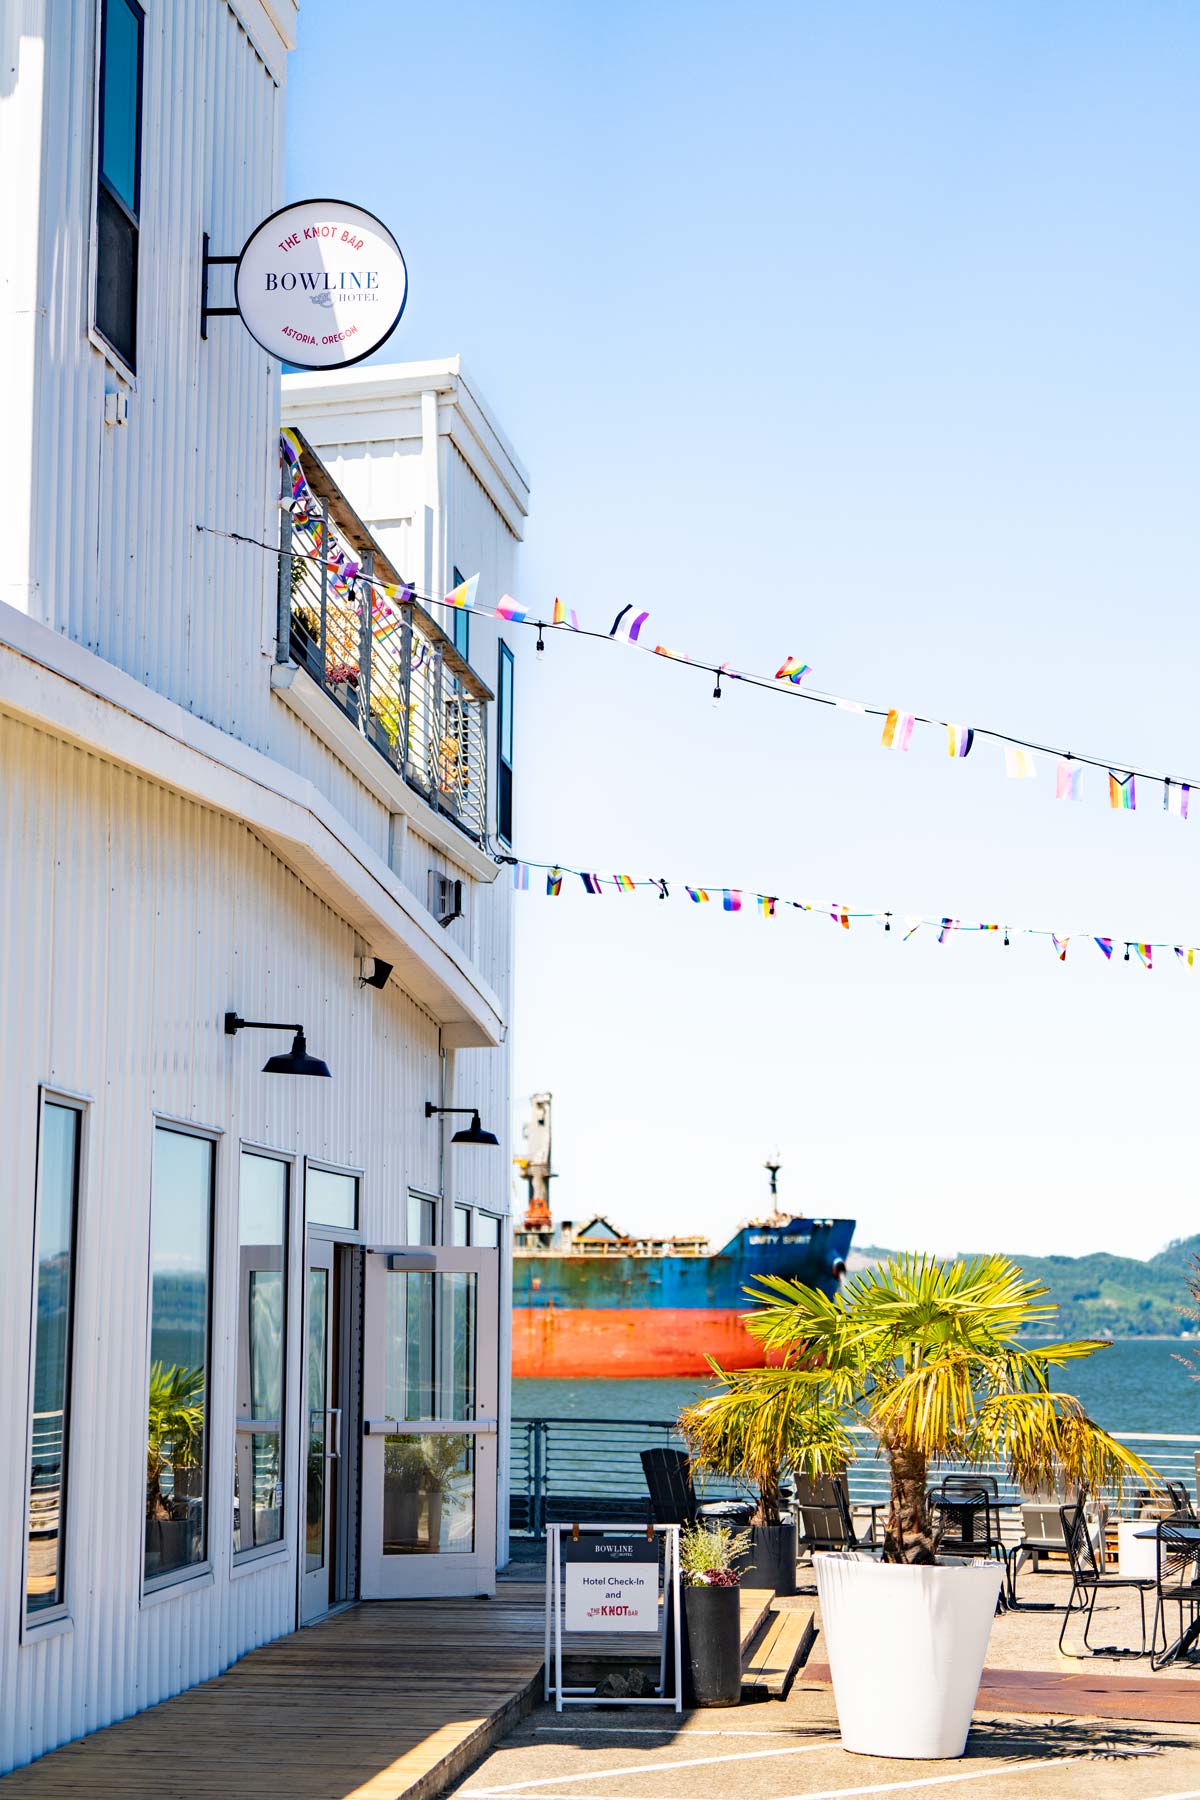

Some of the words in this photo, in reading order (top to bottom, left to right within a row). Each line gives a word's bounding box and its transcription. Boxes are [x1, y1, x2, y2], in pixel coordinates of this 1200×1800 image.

[278, 233, 301, 252] THE
[303, 226, 338, 240] KNOT
[341, 230, 365, 251] BAR
[264, 271, 379, 290] BOWLINE
[339, 293, 379, 302] HOTEL
[281, 326, 319, 346] ASTORIA,
[321, 325, 359, 345] OREGON
[595, 1545, 634, 1553] BOWLINE
[582, 1577, 606, 1585] Hotel
[608, 1577, 645, 1585] Check-In
[605, 1591, 622, 1599] and
[601, 1605, 629, 1616] KNOT
